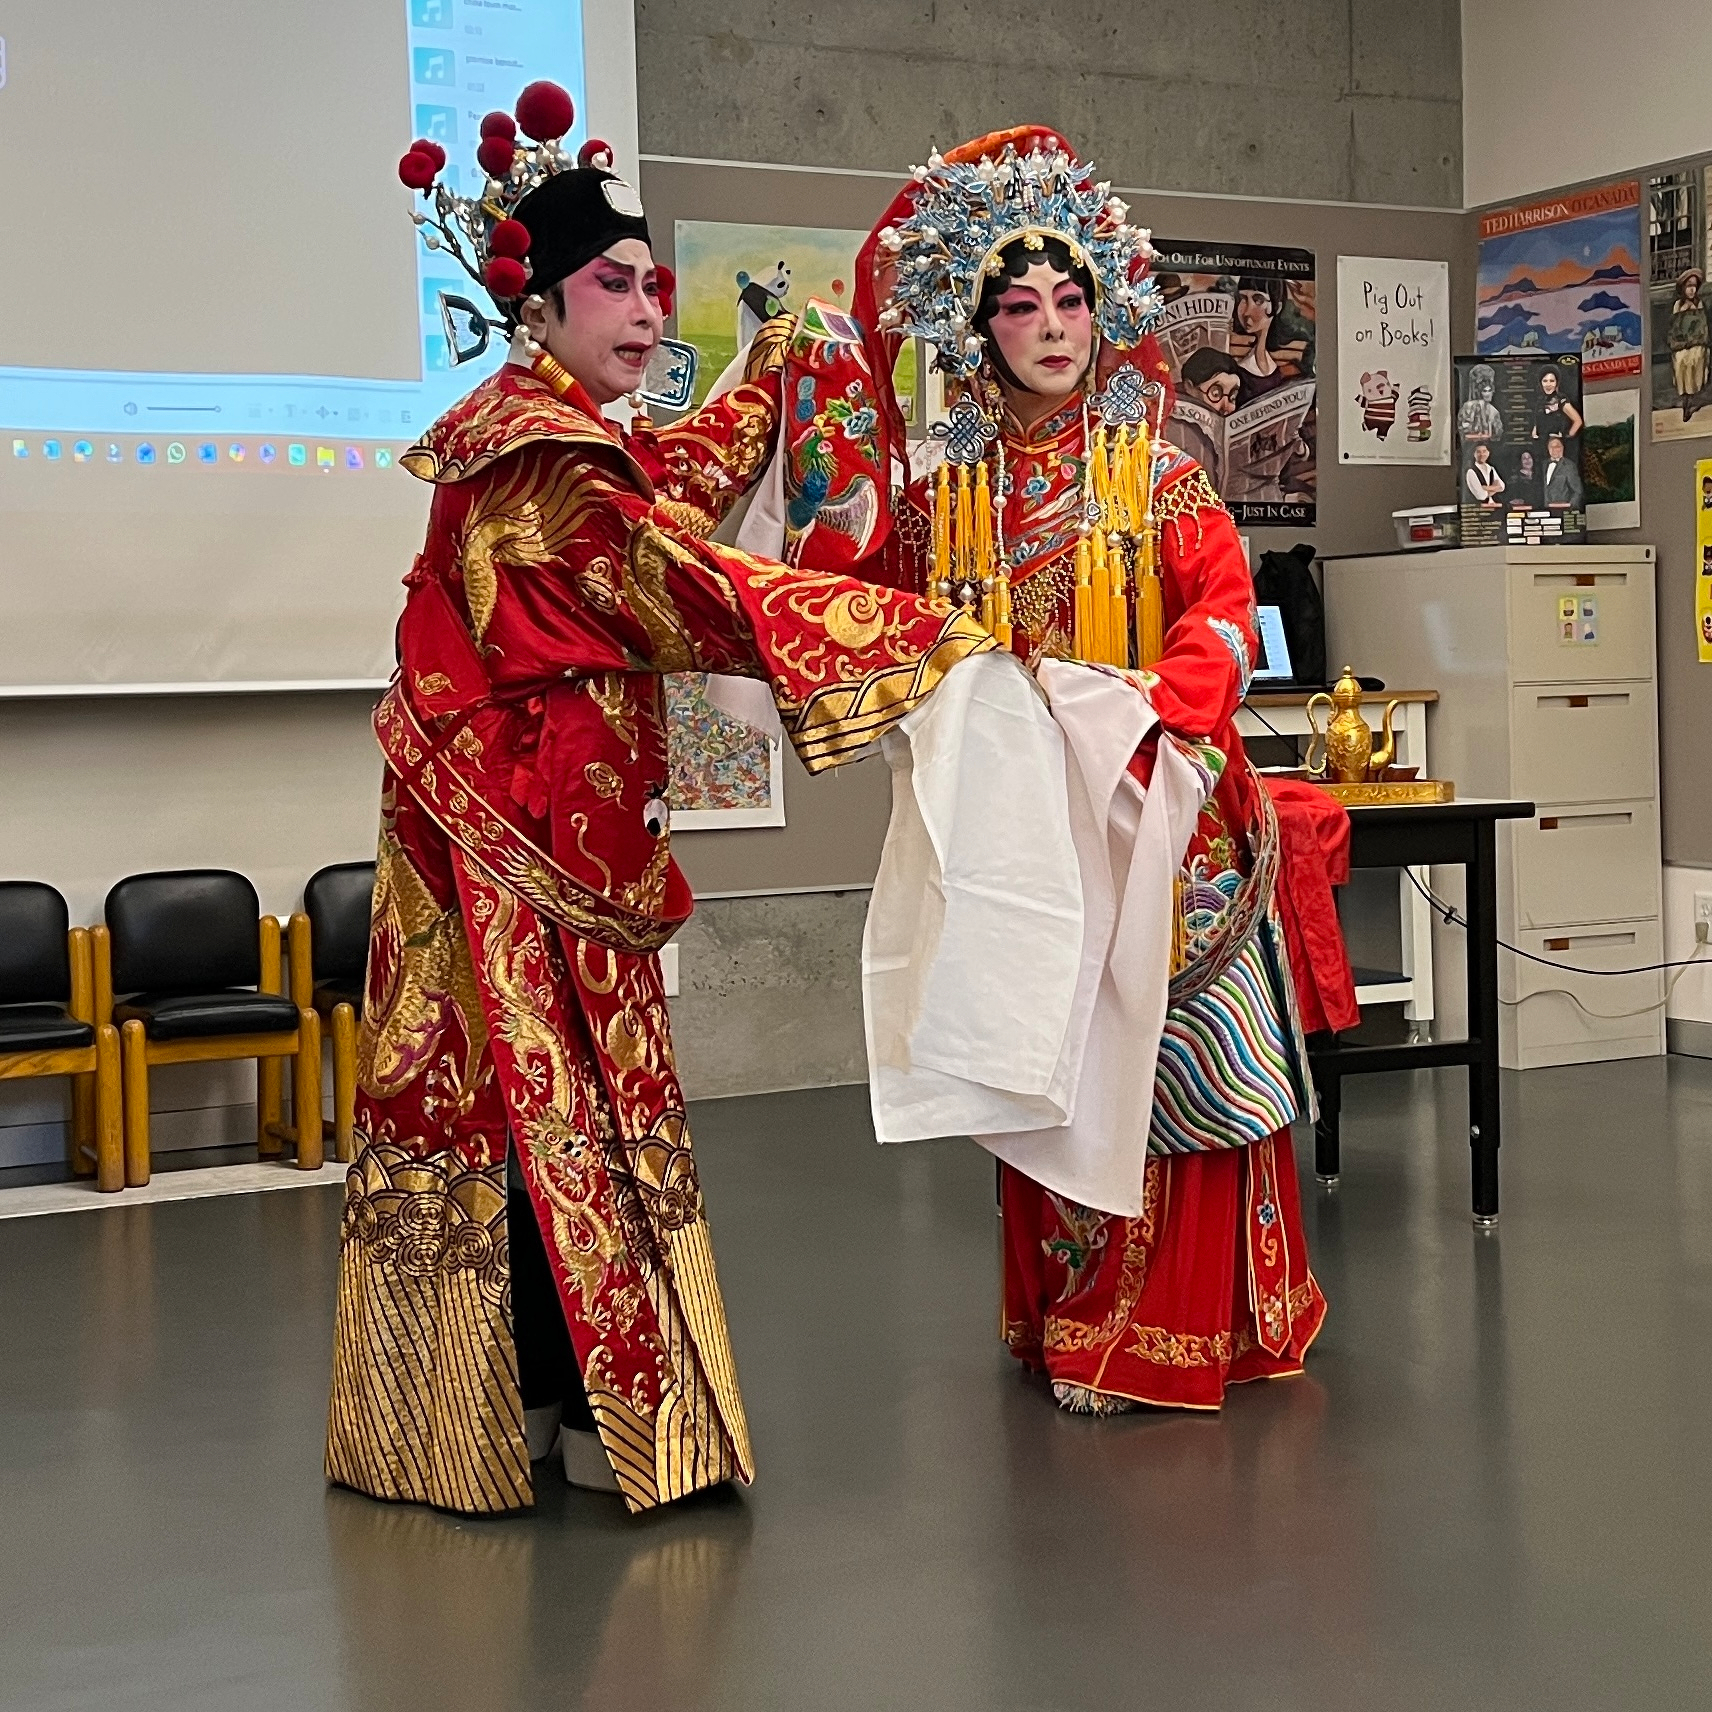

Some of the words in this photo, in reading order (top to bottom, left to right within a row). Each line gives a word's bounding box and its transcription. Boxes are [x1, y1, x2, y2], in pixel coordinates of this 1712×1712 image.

[1484, 215, 1508, 234] TED
[1509, 203, 1569, 229] HARRISON
[1171, 252, 1193, 265] OUT
[1195, 253, 1214, 266] FOR
[1216, 254, 1276, 270] UNFORTUNATE
[1277, 259, 1310, 272] EVENTS
[1363, 281, 1388, 314] Pig
[1395, 283, 1423, 310] Out
[1154, 304, 1182, 329] UN!
[1184, 298, 1229, 316] HIDE!
[1355, 329, 1373, 342] on
[1379, 318, 1434, 347] Books!
[1229, 414, 1249, 430] ONE
[1250, 399, 1283, 420] BEHIND
[1282, 389, 1307, 406] YOU!
[1267, 505, 1279, 518] IN
[1280, 505, 1306, 518] CASE
